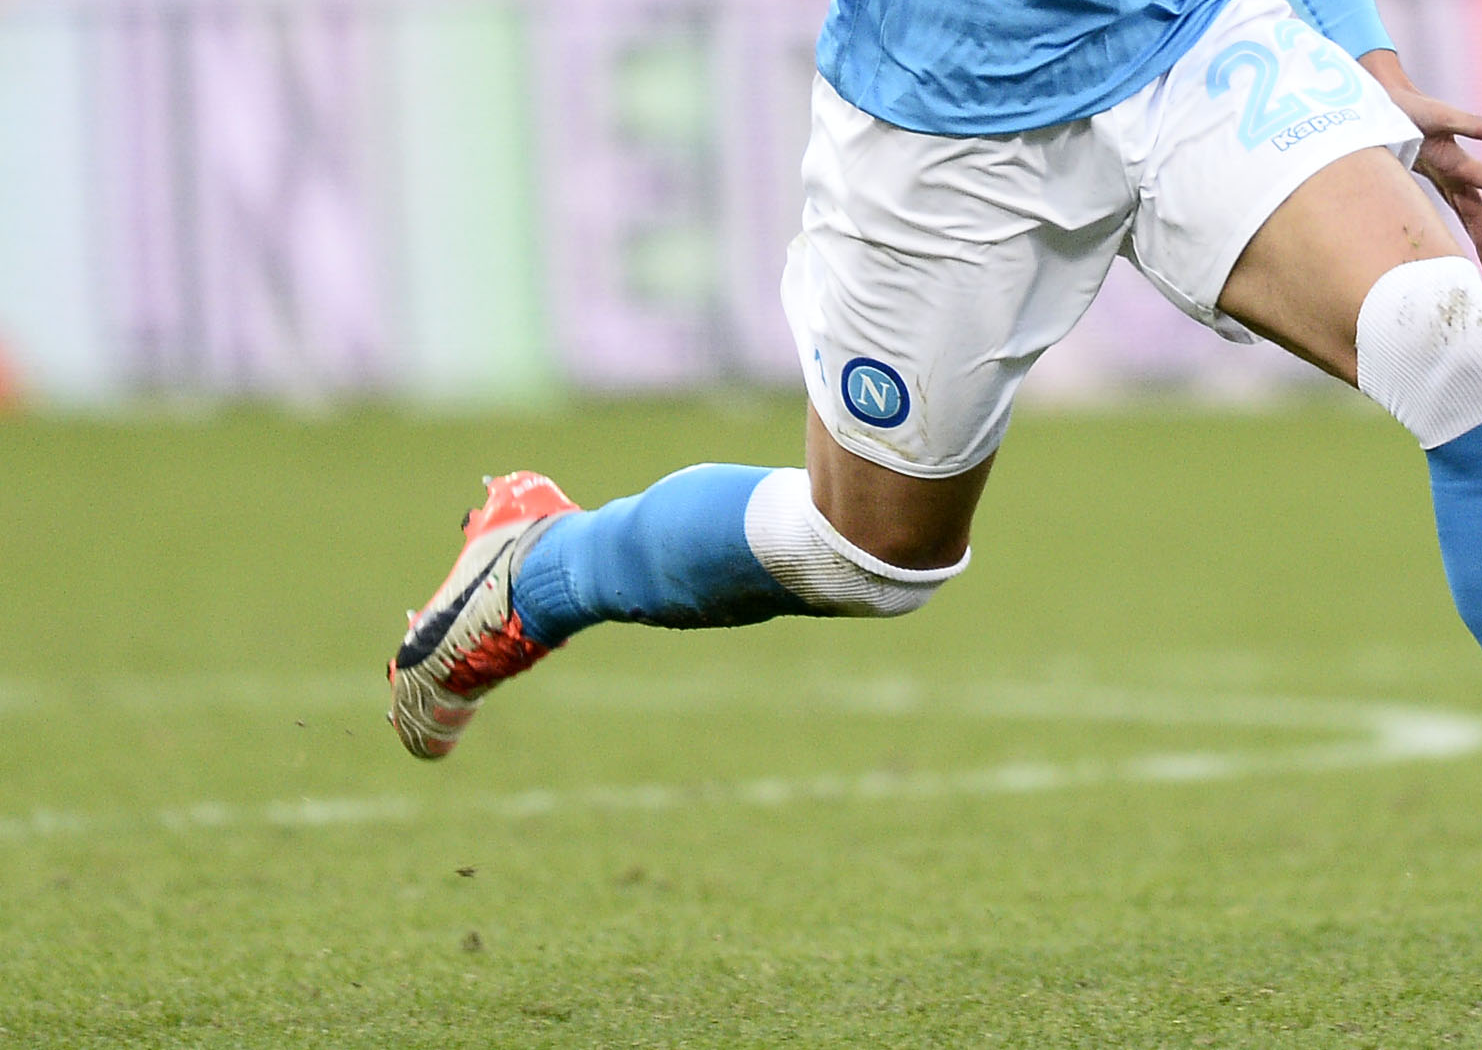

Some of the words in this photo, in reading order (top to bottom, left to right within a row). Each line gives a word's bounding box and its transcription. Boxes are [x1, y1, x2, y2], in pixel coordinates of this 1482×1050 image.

[1205, 18, 1364, 153] 23
[1271, 107, 1362, 152] Kappa
[856, 372, 890, 413] N
